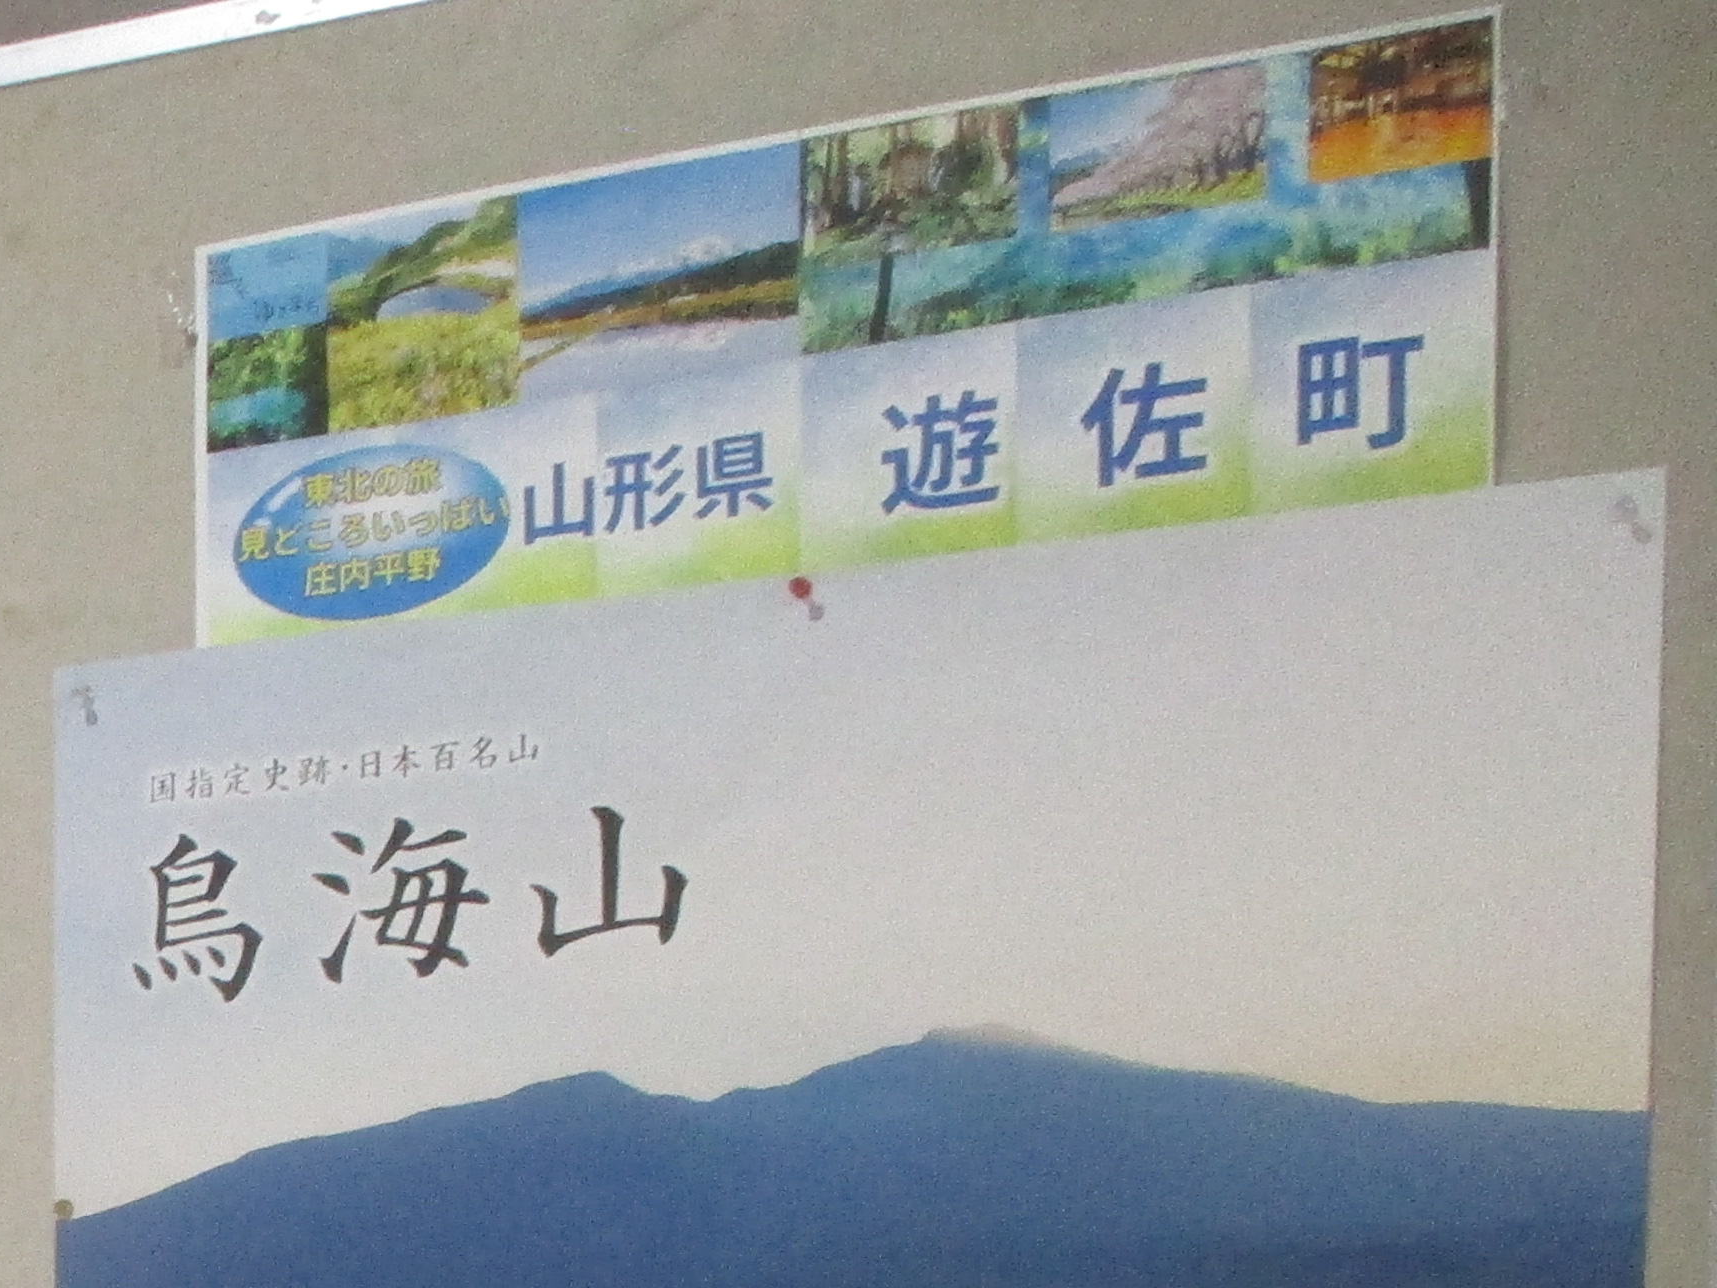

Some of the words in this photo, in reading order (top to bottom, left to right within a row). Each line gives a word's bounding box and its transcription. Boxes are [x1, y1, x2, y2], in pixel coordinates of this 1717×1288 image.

[520, 431, 773, 547] 山形県
[879, 333, 1426, 518] 遊佐町
[302, 457, 442, 508] 東北の旅
[303, 546, 442, 598] 庄内平野
[148, 731, 541, 804] 国指定史跡・日本百名山
[132, 805, 689, 1003] 鳥海山
